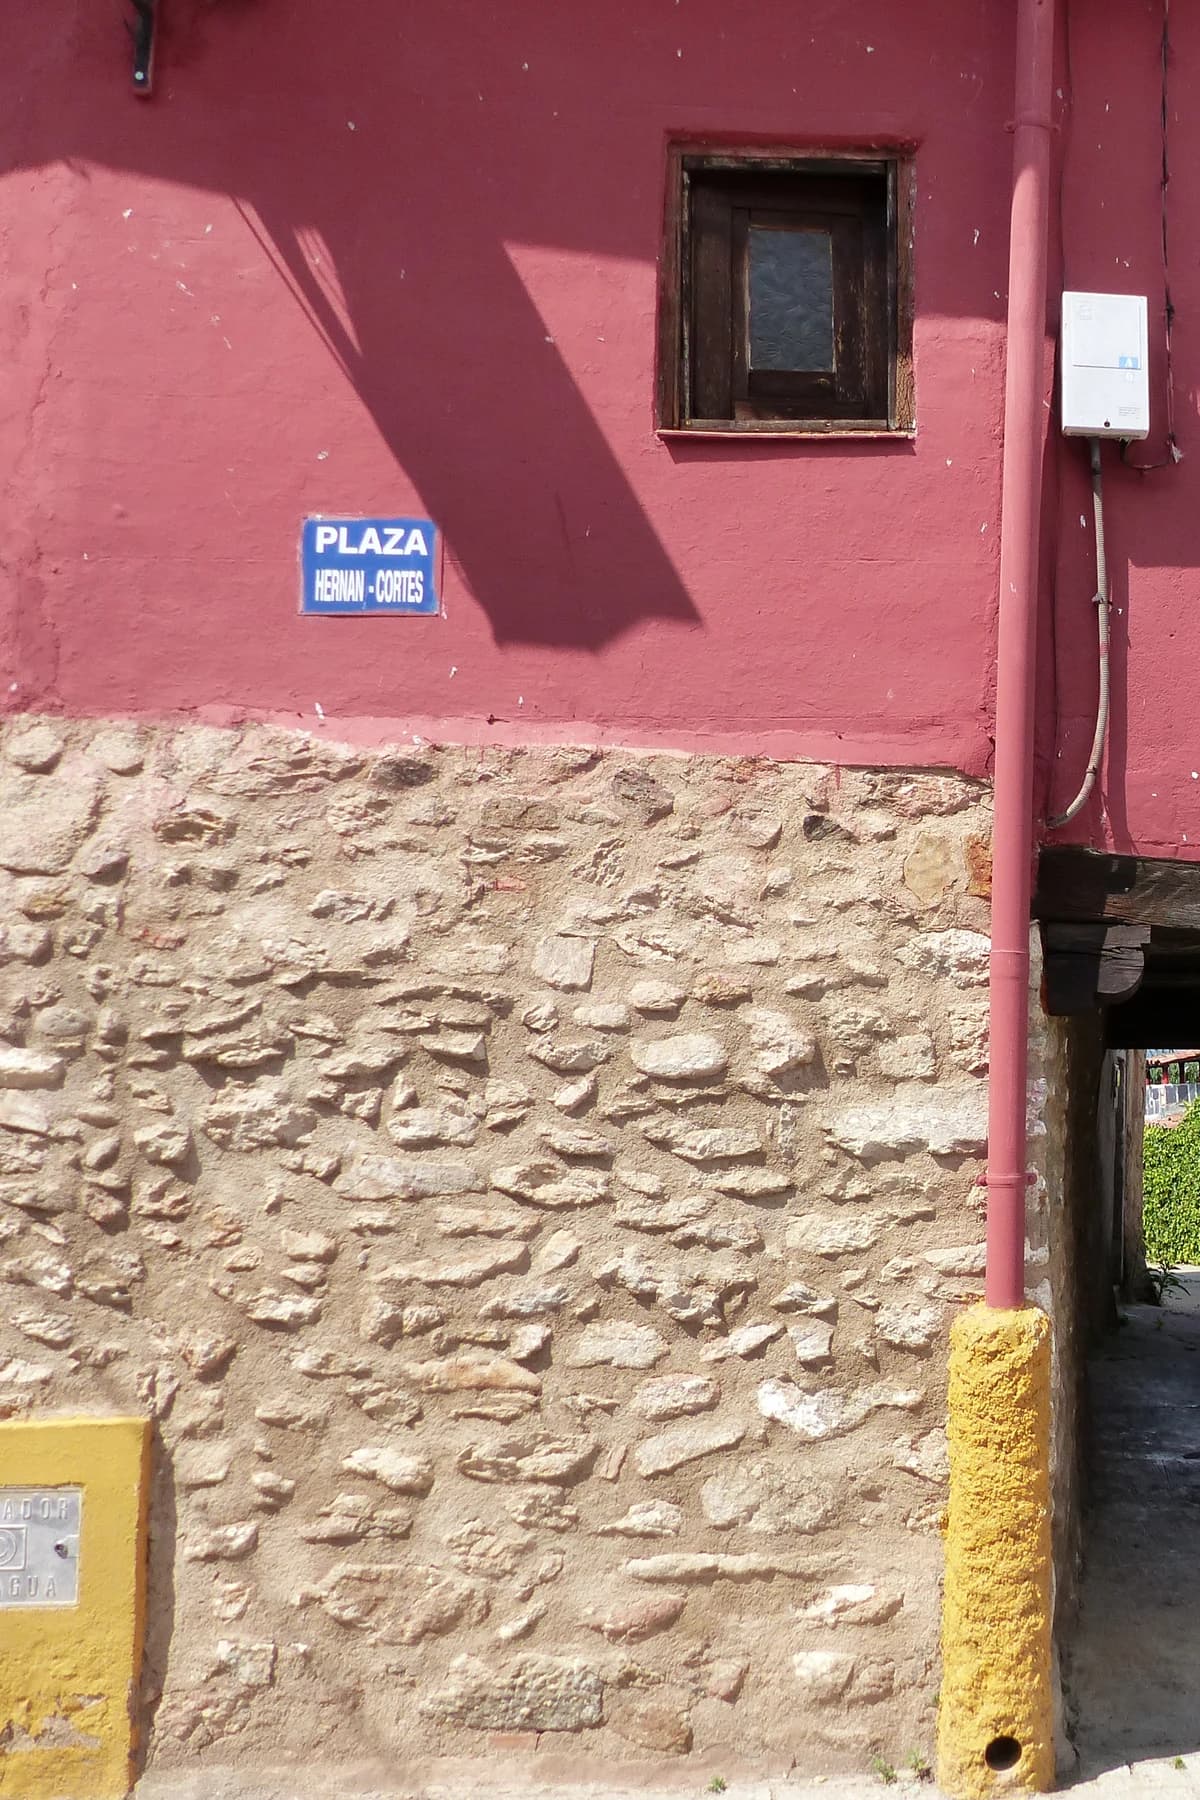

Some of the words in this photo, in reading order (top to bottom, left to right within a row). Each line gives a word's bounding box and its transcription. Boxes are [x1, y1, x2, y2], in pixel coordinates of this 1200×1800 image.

[315, 526, 428, 556] PLAZA
[314, 569, 365, 602] HERNAN
[375, 569, 424, 603] CORTES
